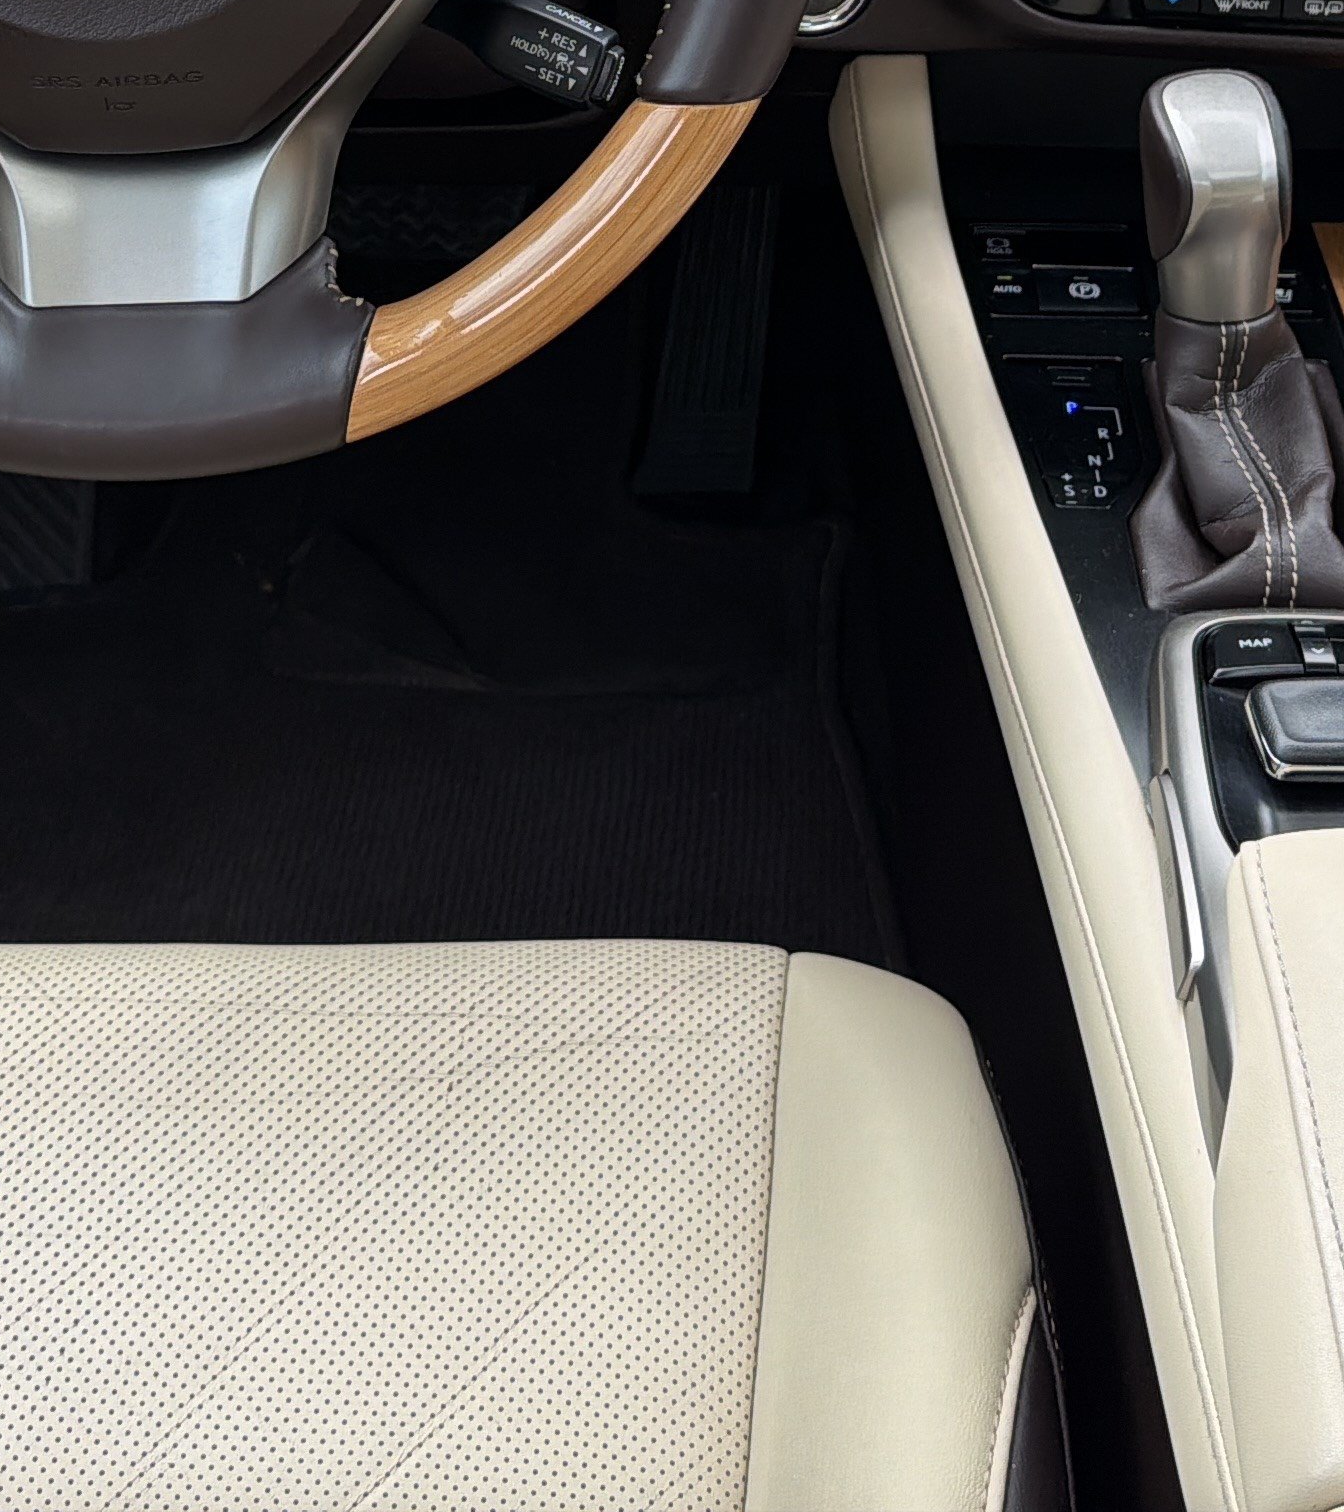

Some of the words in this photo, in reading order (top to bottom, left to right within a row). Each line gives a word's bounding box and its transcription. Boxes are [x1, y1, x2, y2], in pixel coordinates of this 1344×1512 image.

[545, 4, 593, 30] CANCEL
[510, 35, 538, 55] HOLD
[550, 32, 578, 52] RES
[95, 70, 205, 88] AIRBAG
[537, 67, 565, 86] SET
[993, 284, 1023, 294] AUTO
[1066, 400, 1078, 414] P
[1097, 427, 1109, 439] R
[1087, 454, 1102, 467] N
[1063, 484, 1076, 497] S
[1093, 486, 1107, 498] D
[1238, 638, 1273, 649] MAP
